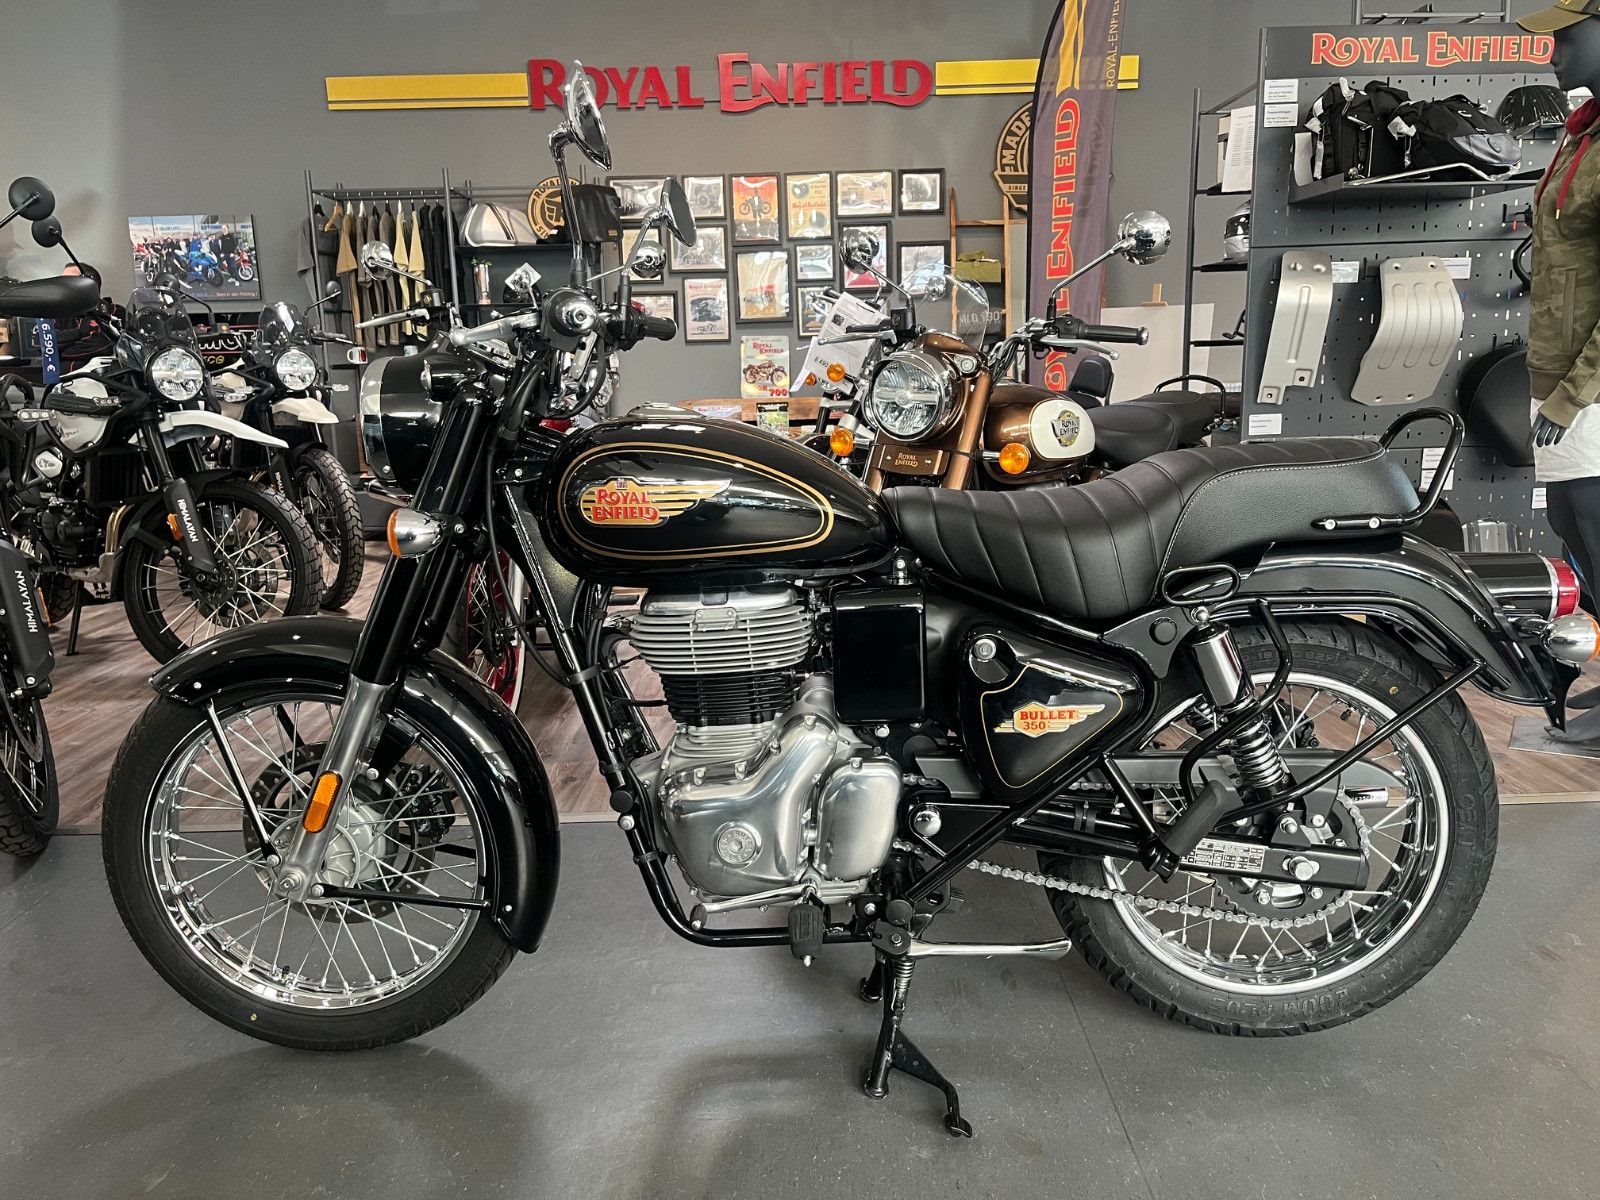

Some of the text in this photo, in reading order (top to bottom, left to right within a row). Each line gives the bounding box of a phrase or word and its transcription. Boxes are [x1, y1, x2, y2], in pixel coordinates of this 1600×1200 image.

[1311, 31, 1555, 67] ROYAL ENFIELD
[717, 52, 933, 112] ENFIELD
[1045, 97, 1081, 279] ENFIELD
[47, 364, 56, 372] €
[768, 388, 788, 397] 700
[898, 452, 916, 461] ROYAL
[595, 488, 651, 506] ROYAL
[177, 498, 199, 543] HIMALAYAN
[591, 505, 660, 522] ENFIELD
[14, 570, 39, 633] HIMALAYAN
[1020, 709, 1076, 721] BULLET
[1022, 721, 1046, 730] 350
